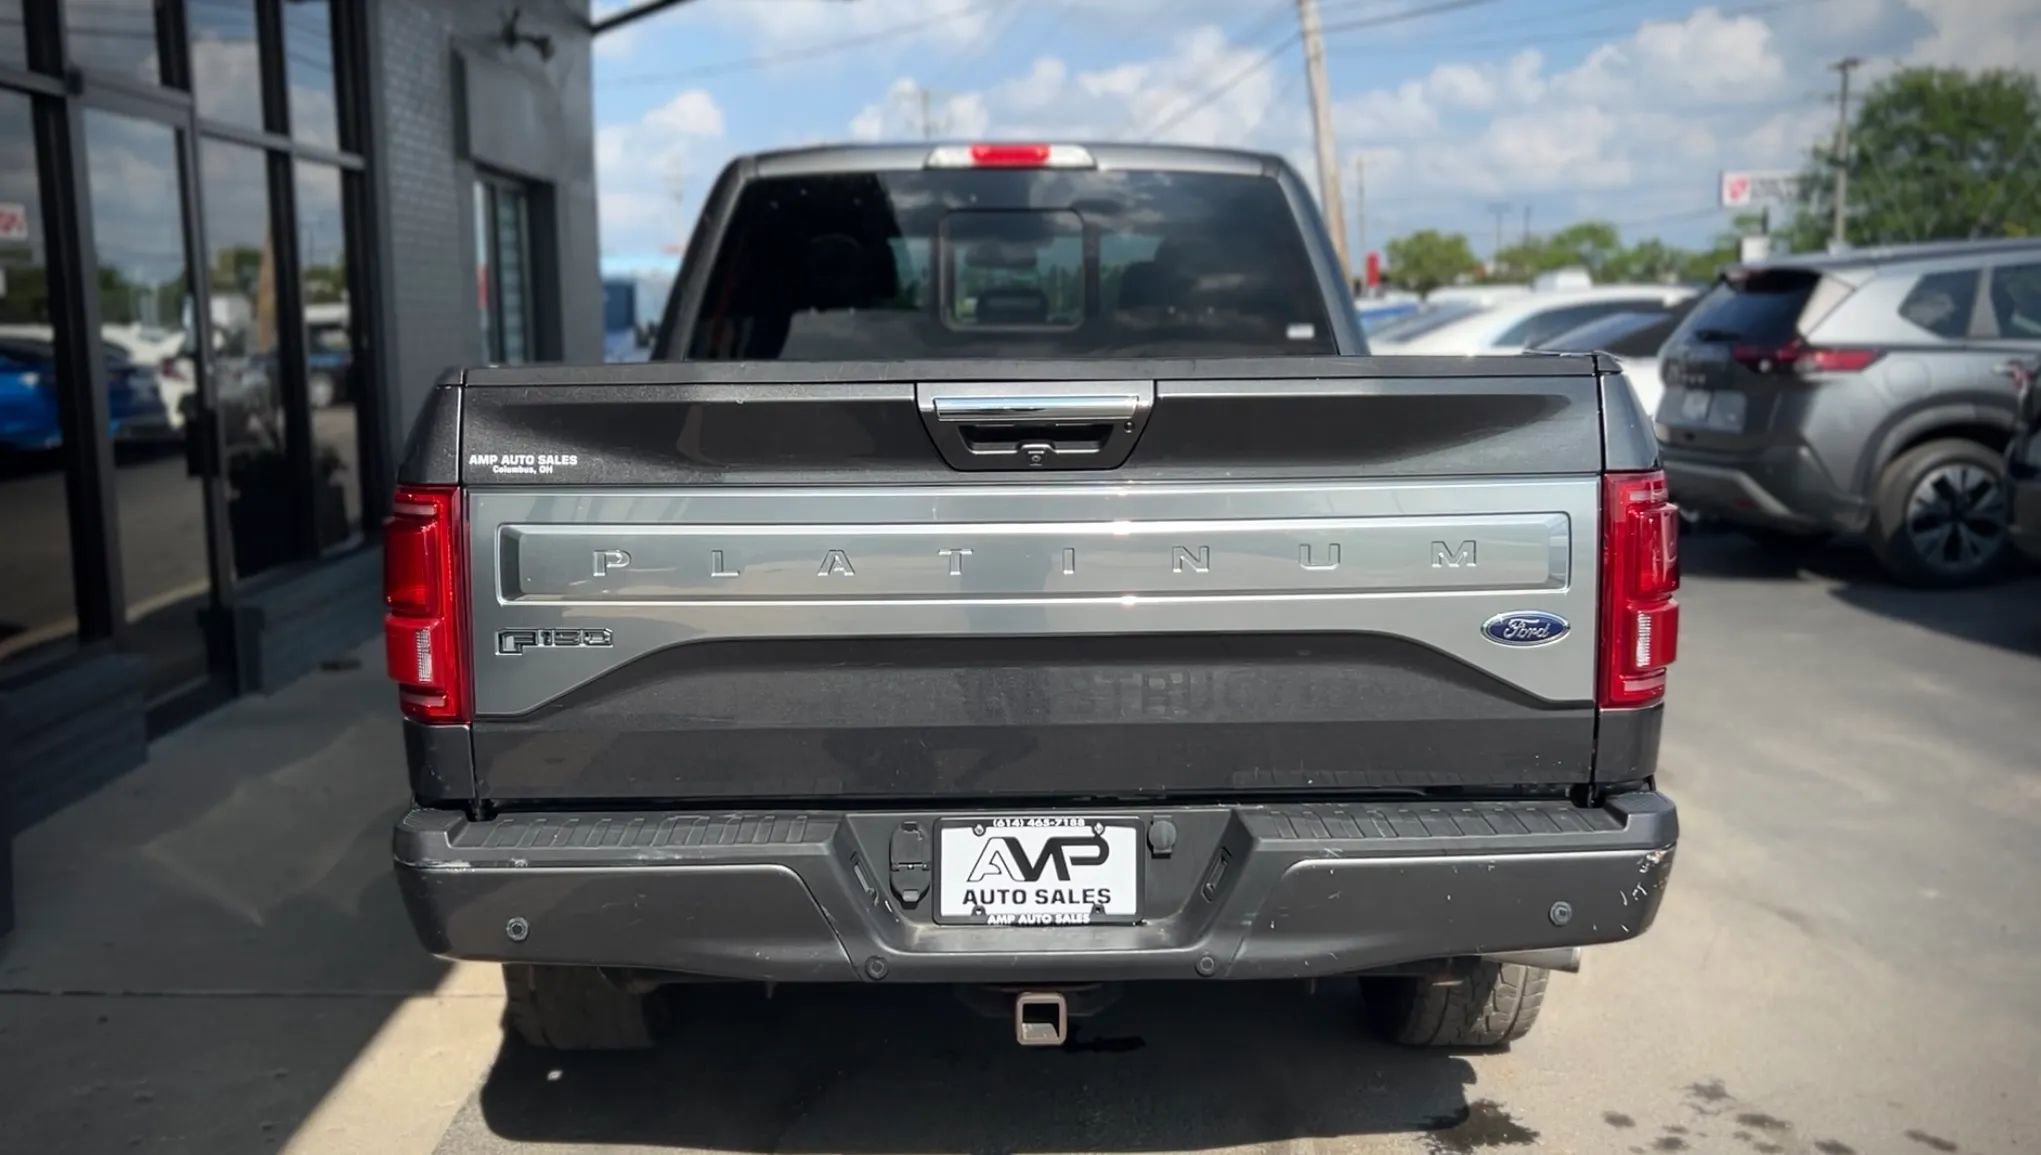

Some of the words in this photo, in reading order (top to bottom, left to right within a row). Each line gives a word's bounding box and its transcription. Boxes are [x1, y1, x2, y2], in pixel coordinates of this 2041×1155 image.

[469, 454, 498, 465] AMP
[501, 454, 535, 465] AUTO
[538, 454, 578, 465] SALES
[492, 465, 537, 474] Columbus,
[539, 465, 553, 474] OH
[593, 539, 1477, 577] PLATINUM
[1503, 618, 1551, 639] Ford
[993, 818, 1024, 827] (614)
[962, 889, 1027, 905] AUTO
[1035, 888, 1111, 905] SALES
[987, 913, 1016, 925] AMP
[1018, 913, 1052, 925] AUTO
[1055, 912, 1090, 925] SALES
